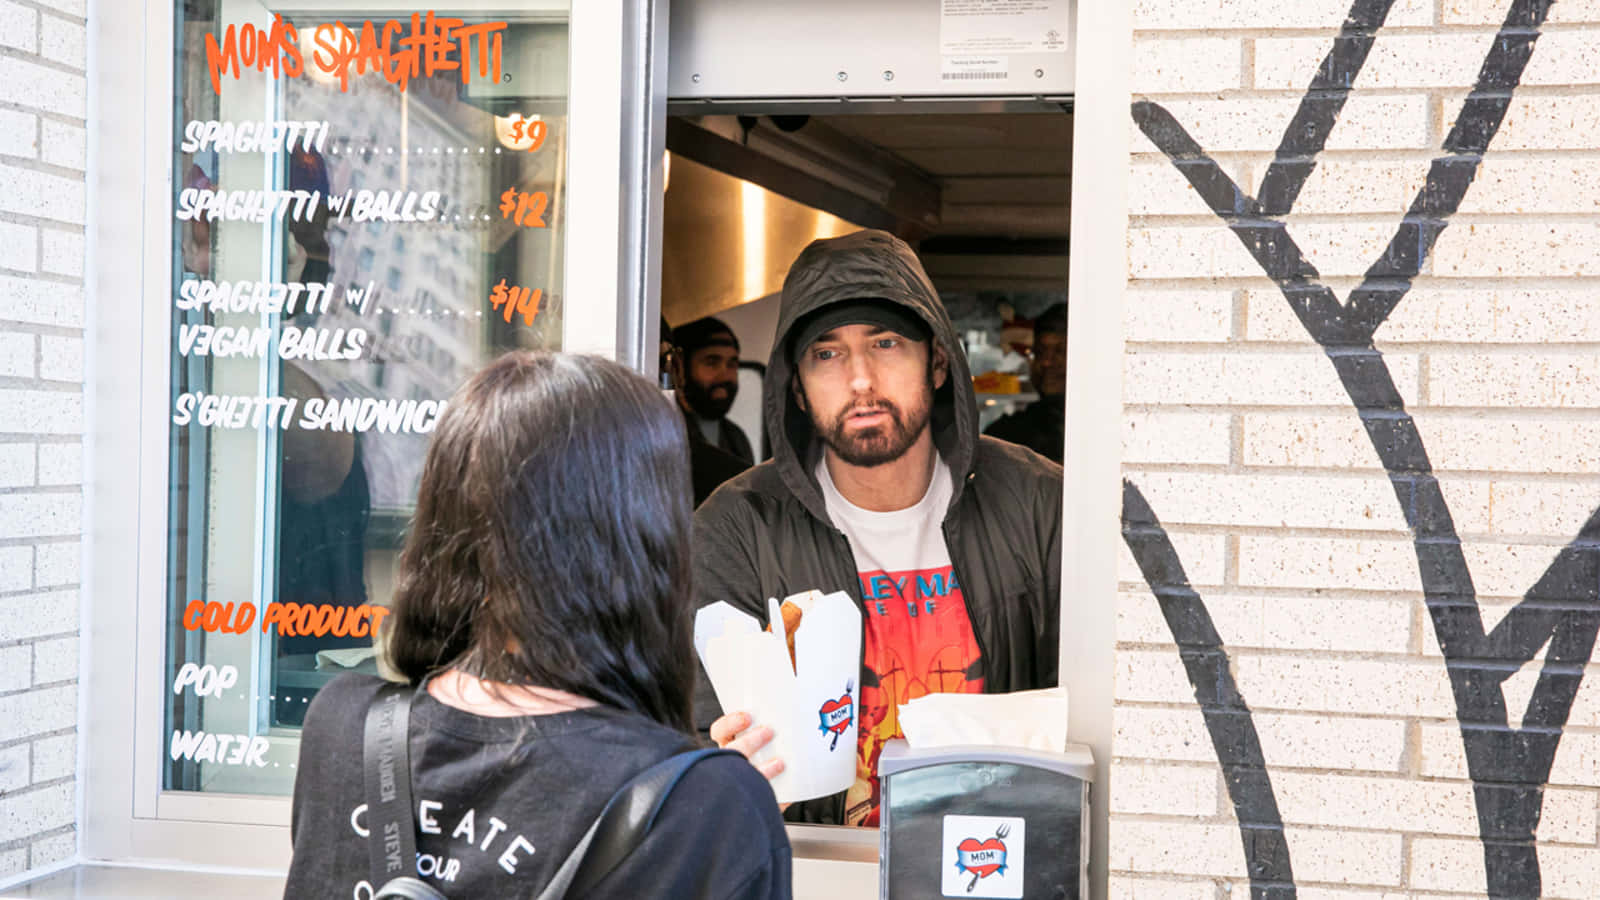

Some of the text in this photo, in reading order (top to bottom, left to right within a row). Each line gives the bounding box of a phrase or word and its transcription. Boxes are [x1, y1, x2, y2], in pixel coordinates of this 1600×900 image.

[205, 10, 508, 95] MOM'S SPAGHETTI
[181, 115, 548, 154] SPAGHETTI $9
[176, 188, 320, 225] SPAGHETTI
[351, 190, 440, 223] BALLS
[499, 187, 548, 228] $12
[175, 279, 334, 314] SPAGHETTI
[489, 278, 543, 327] $14
[178, 323, 367, 361] VEGAN BALLS
[173, 392, 296, 429] S'GHETTI
[183, 599, 390, 638] COLD PRODUCT
[174, 662, 238, 698] POP
[830, 706, 848, 721] MOM
[170, 730, 270, 768] WATER
[351, 800, 537, 875] CEATE
[384, 821, 403, 873] STEVE
[971, 850, 995, 862] MOM
[416, 852, 461, 882] OUR
